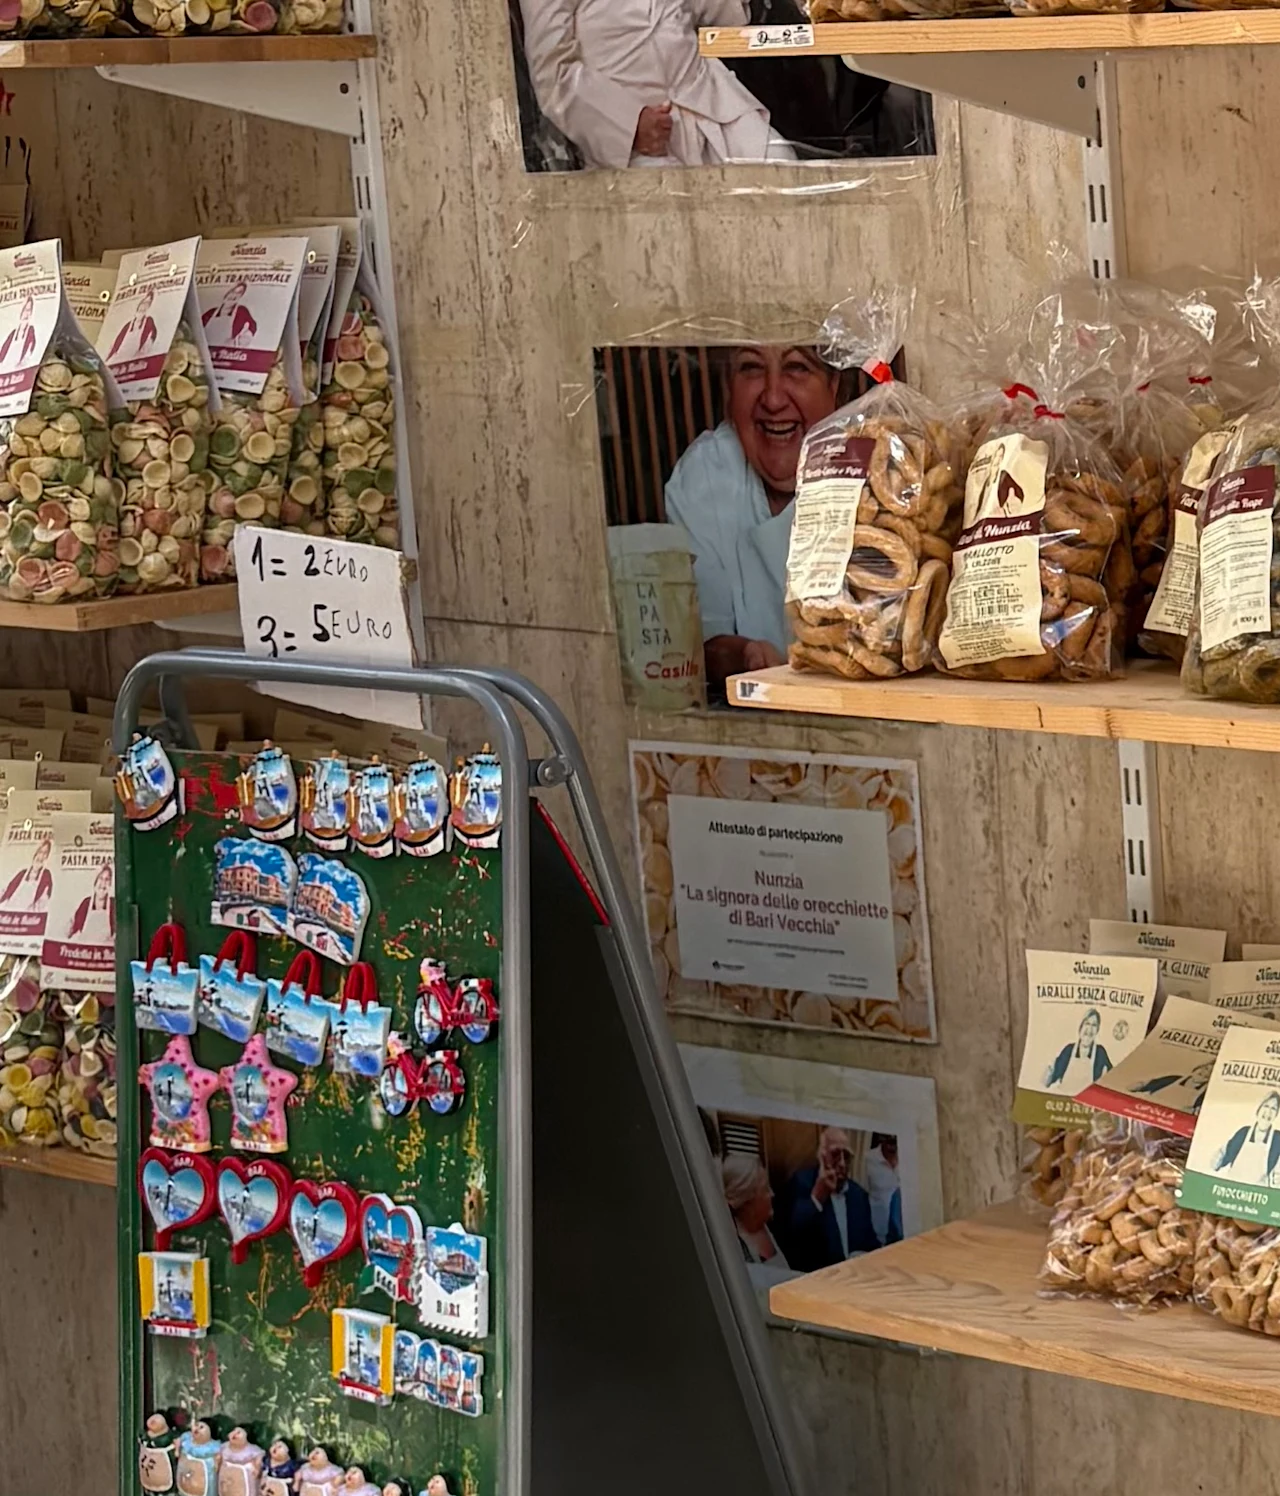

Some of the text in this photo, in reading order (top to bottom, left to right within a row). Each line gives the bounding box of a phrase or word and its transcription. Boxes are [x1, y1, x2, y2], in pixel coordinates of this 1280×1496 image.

[225, 271, 292, 285] TRADIZIONALE
[983, 519, 1033, 538] Nunzia
[708, 820, 843, 845] Attestato di partecipazione
[61, 855, 88, 867] PASTA
[754, 870, 804, 890] Nunzia
[680, 883, 889, 920] "La signora delle orecchiette
[729, 909, 841, 936] di Bari Vecchia"
[1171, 961, 1211, 980] GLUTINE
[1036, 984, 1146, 1008] TARALLI SENZA GLUTINE
[1215, 996, 1254, 1008] TARALLI
[1159, 1029, 1204, 1048] TARALLI
[1221, 1063, 1260, 1079] TARALLI
[1211, 1184, 1269, 1206] FINOCCHIETTO
[436, 1300, 460, 1318] BARI
